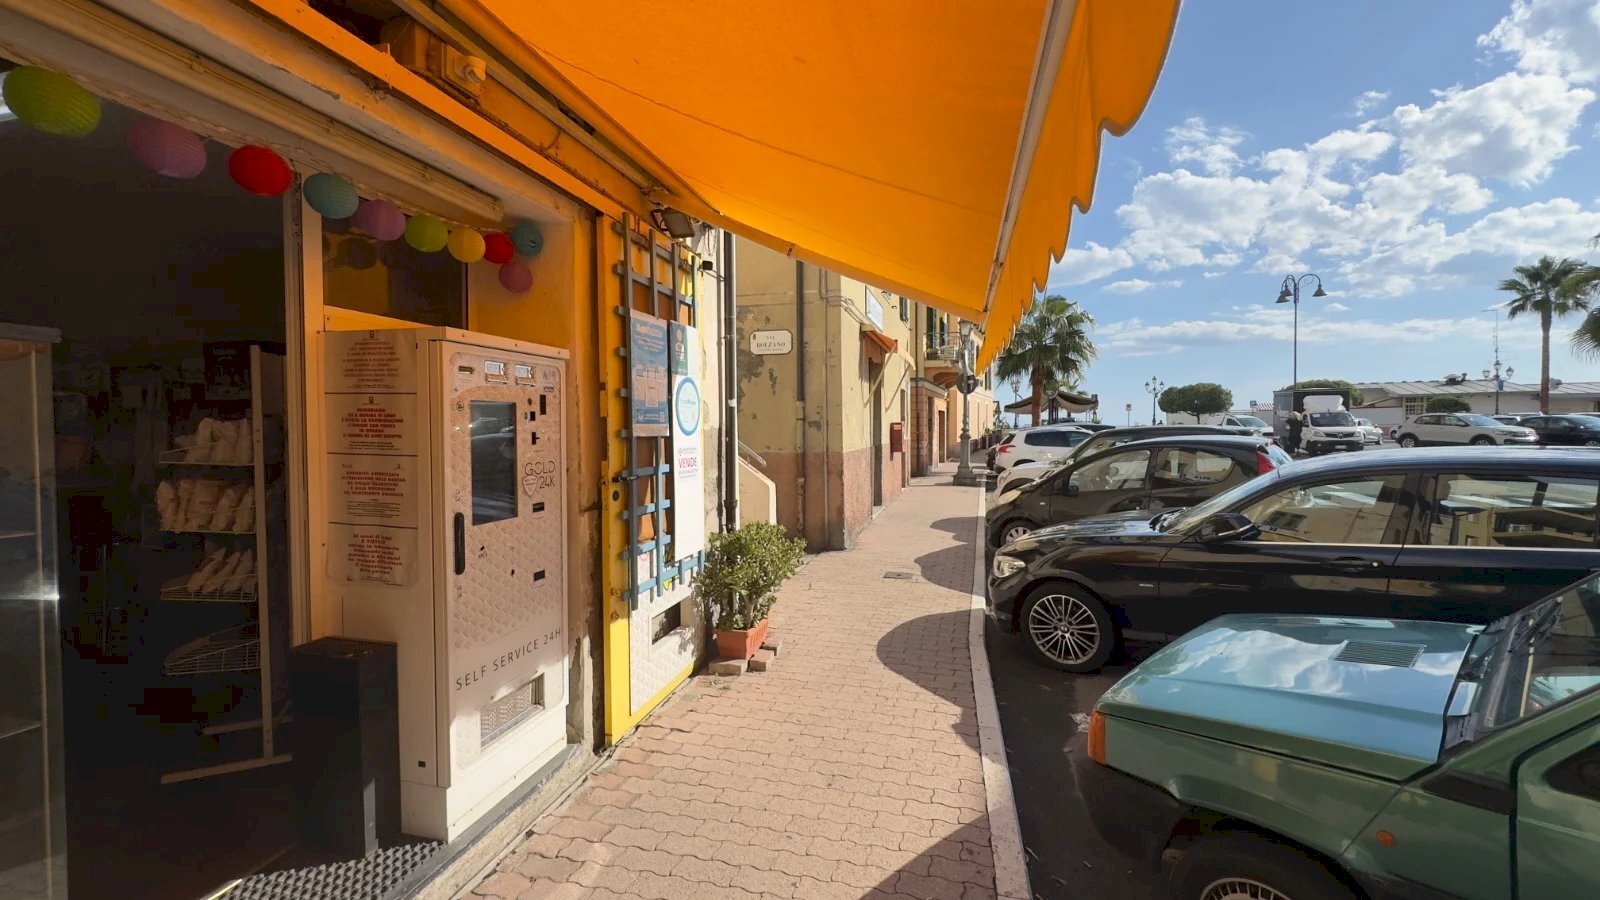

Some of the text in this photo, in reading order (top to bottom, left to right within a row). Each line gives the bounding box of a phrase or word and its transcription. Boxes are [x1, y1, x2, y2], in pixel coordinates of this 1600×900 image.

[525, 460, 556, 476] GOLD
[679, 457, 697, 469] VENDE
[539, 475, 556, 489] 24K
[455, 627, 562, 691] SELF SERVICE 24H
